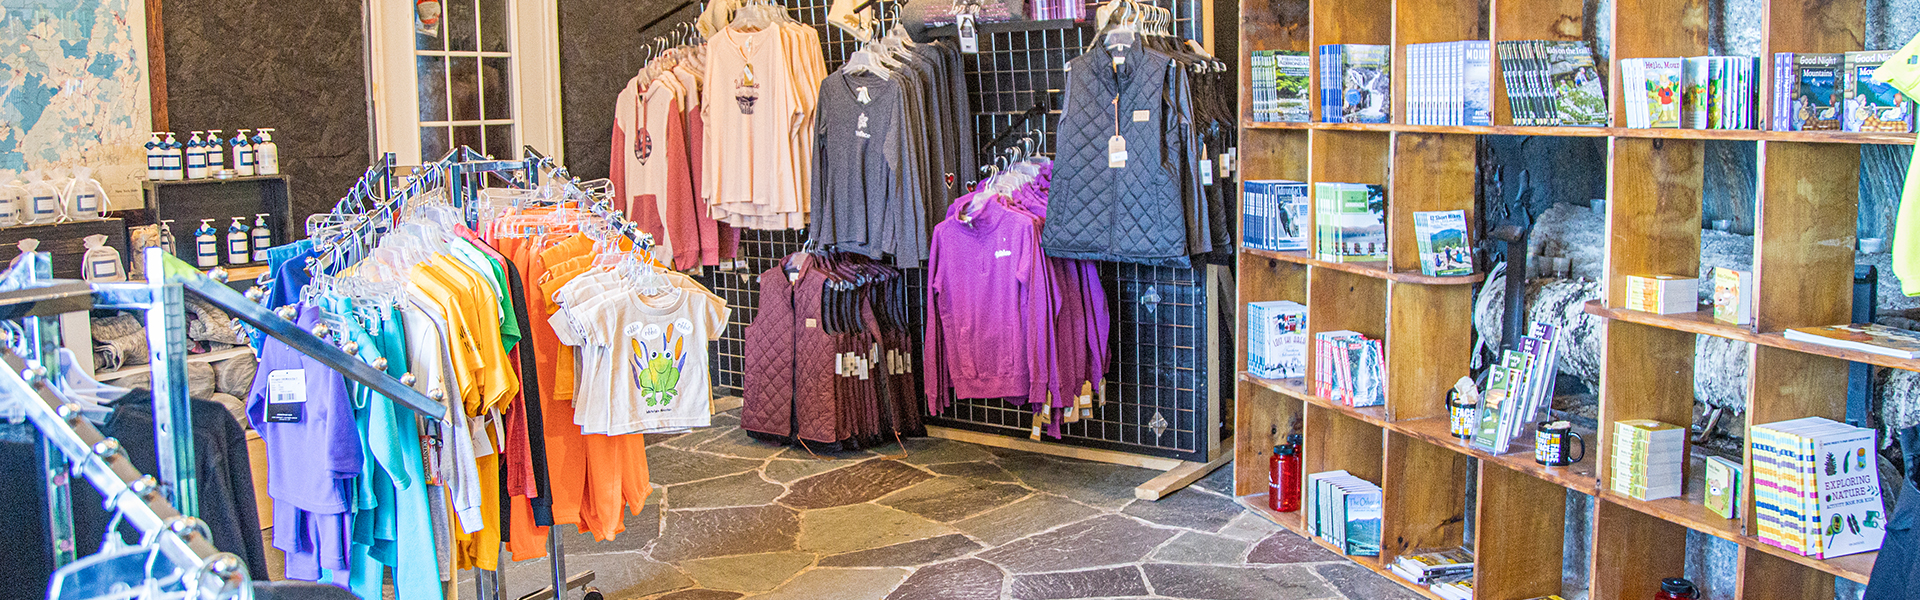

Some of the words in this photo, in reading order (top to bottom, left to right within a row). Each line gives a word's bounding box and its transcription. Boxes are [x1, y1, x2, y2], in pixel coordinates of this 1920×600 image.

[1800, 56, 1817, 64] Good
[1818, 56, 1836, 66] Night
[1855, 54, 1876, 62] Good
[1645, 61, 1663, 69] Hello,
[1456, 407, 1474, 418] FACE
[1824, 475, 1870, 490] EXPLORING
[1832, 487, 1866, 500] NATURE
